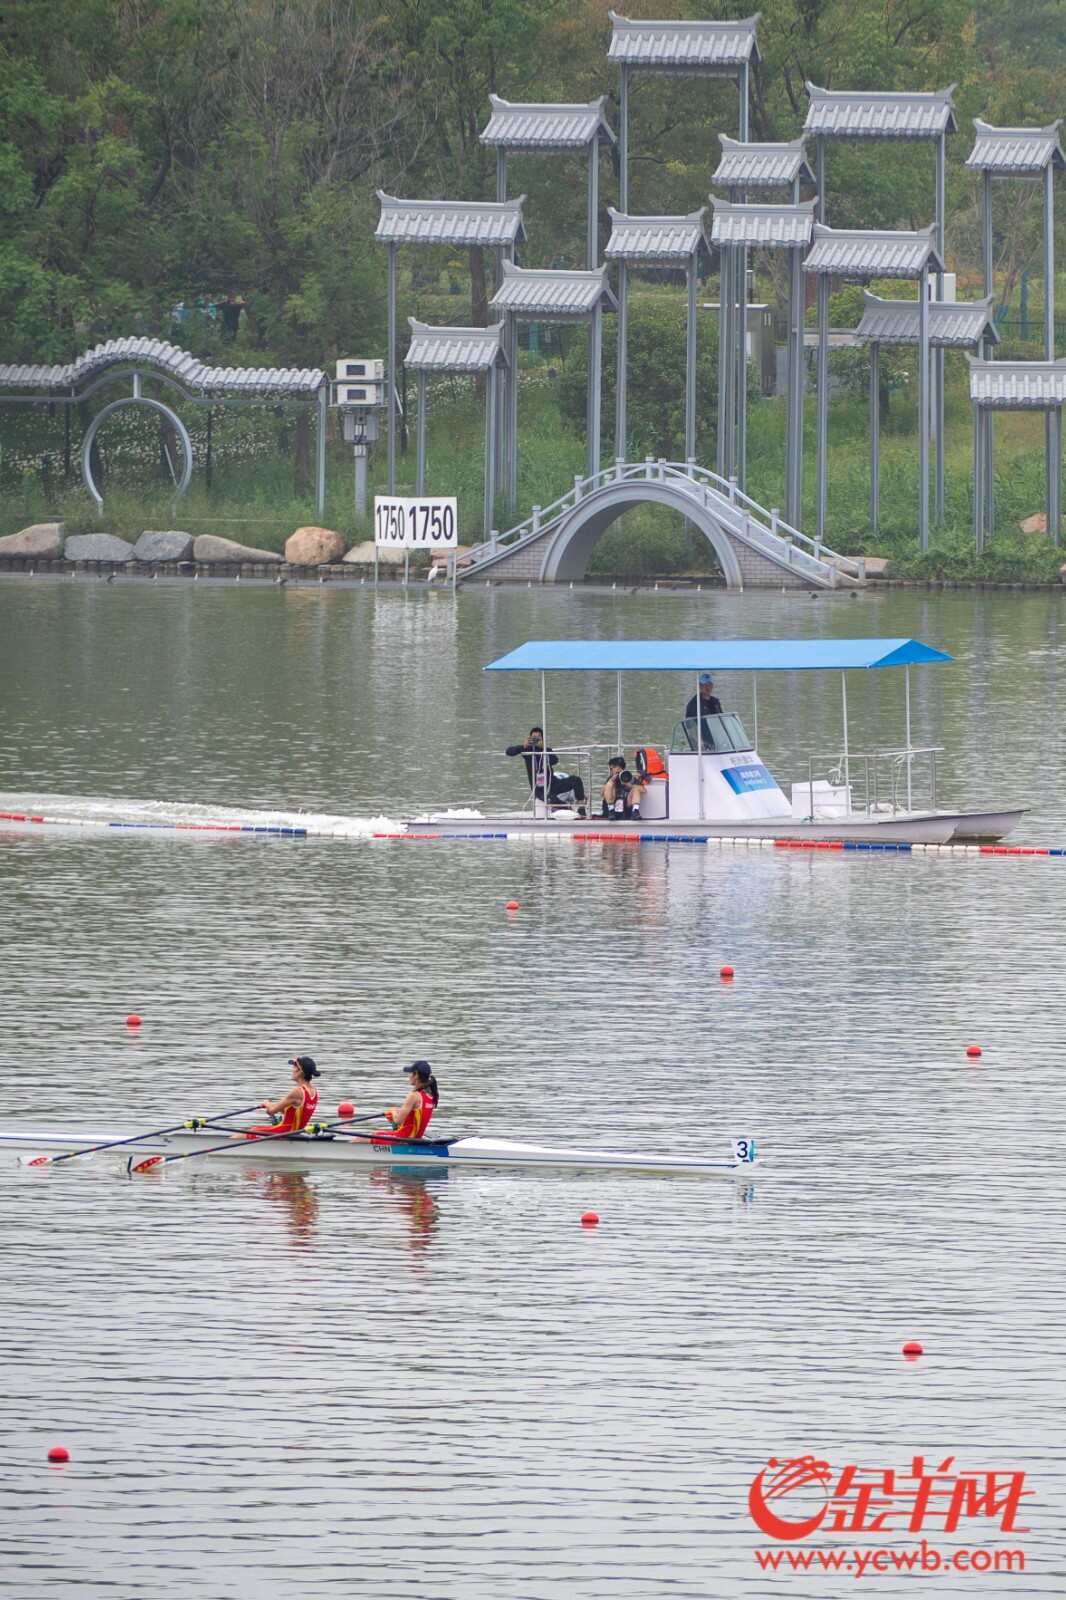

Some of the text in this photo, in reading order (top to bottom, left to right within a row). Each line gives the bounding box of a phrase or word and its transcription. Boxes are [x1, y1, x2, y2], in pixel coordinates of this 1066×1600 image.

[376, 504, 405, 541] 1750
[409, 504, 454, 541] 1750
[373, 1145, 391, 1153] CHN
[736, 1140, 748, 1159] 3
